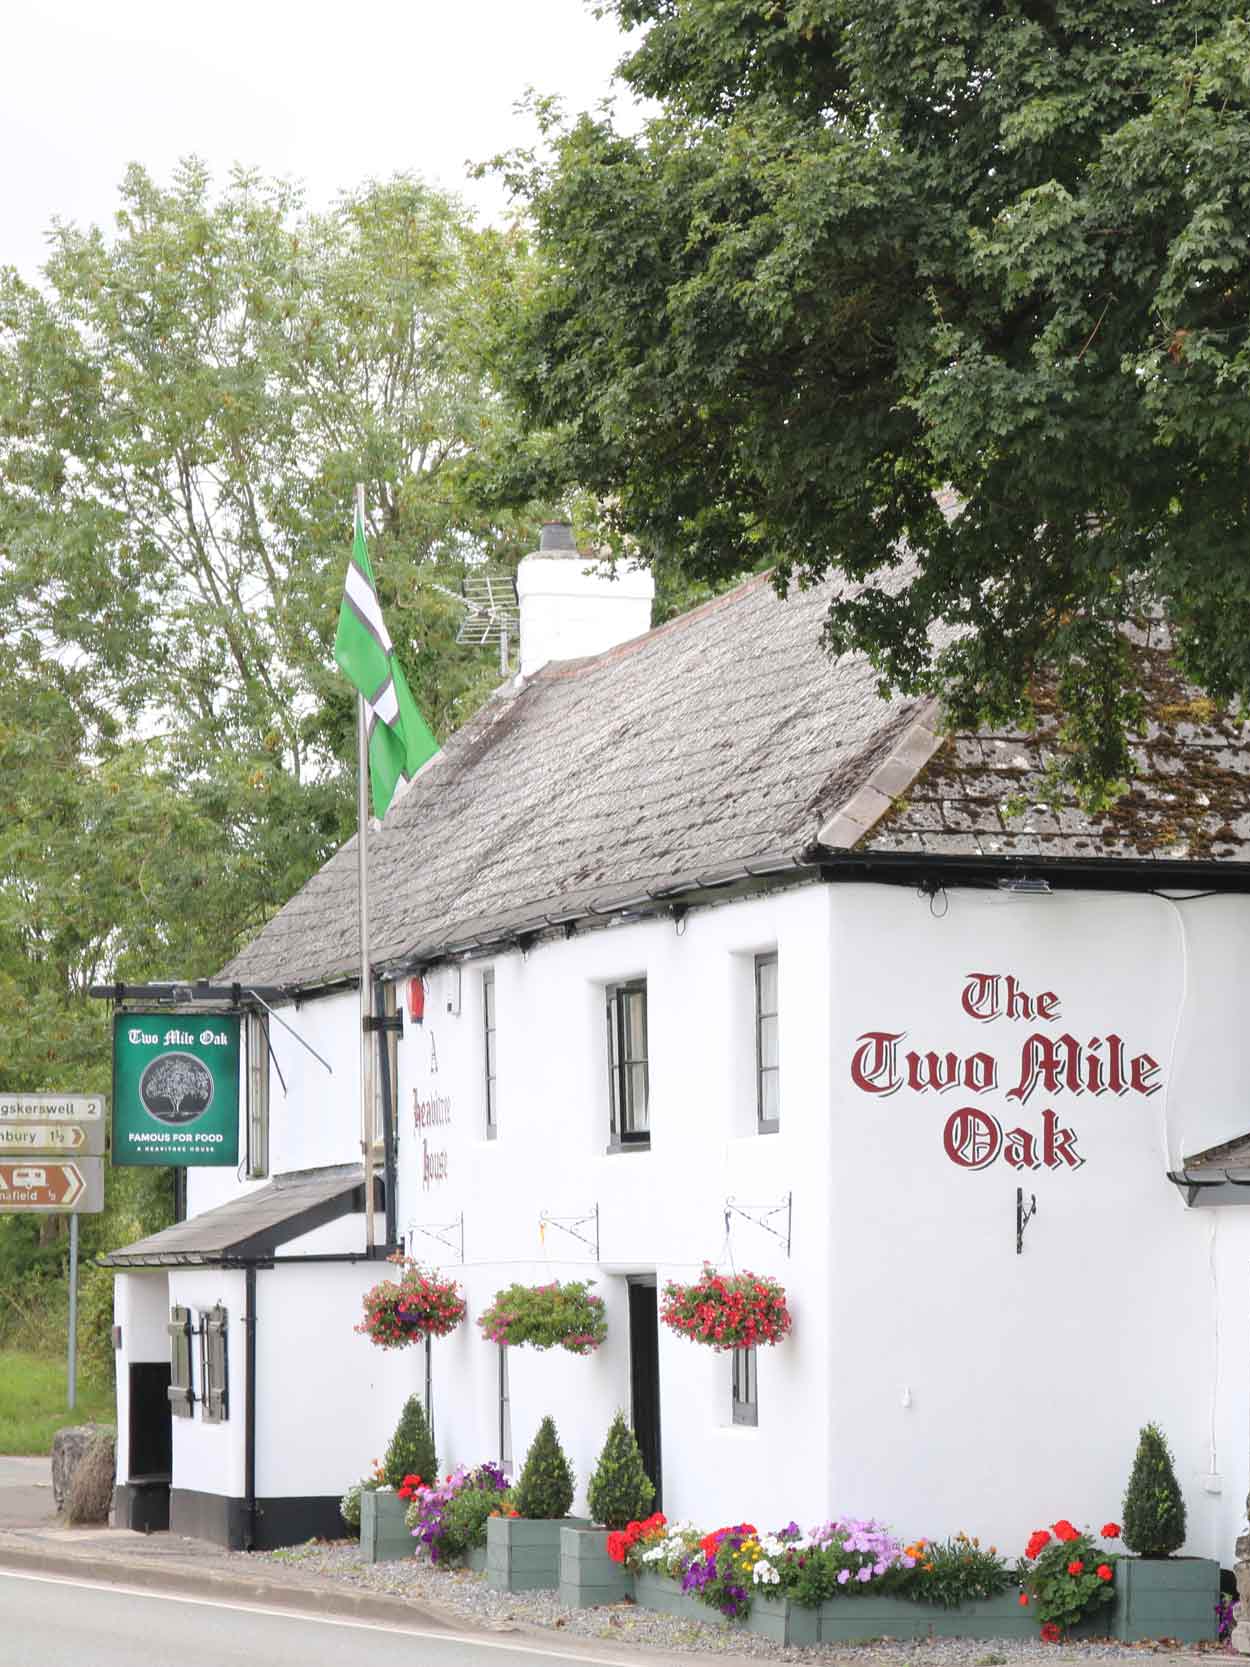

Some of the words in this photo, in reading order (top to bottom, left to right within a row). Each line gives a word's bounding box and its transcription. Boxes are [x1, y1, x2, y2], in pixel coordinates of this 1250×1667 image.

[961, 972, 1062, 1023] The
[128, 1029, 158, 1044] Two
[163, 1029, 194, 1046] Mile
[200, 1029, 228, 1046] Oak
[850, 1031, 998, 1097] Two
[1005, 1032, 1163, 1105] Mile
[87, 1103, 96, 1114] 2
[128, 1132, 170, 1142] FAMOUS
[172, 1133, 192, 1142] FOR
[195, 1132, 223, 1142] FOOD
[943, 1107, 1086, 1171] Oak
